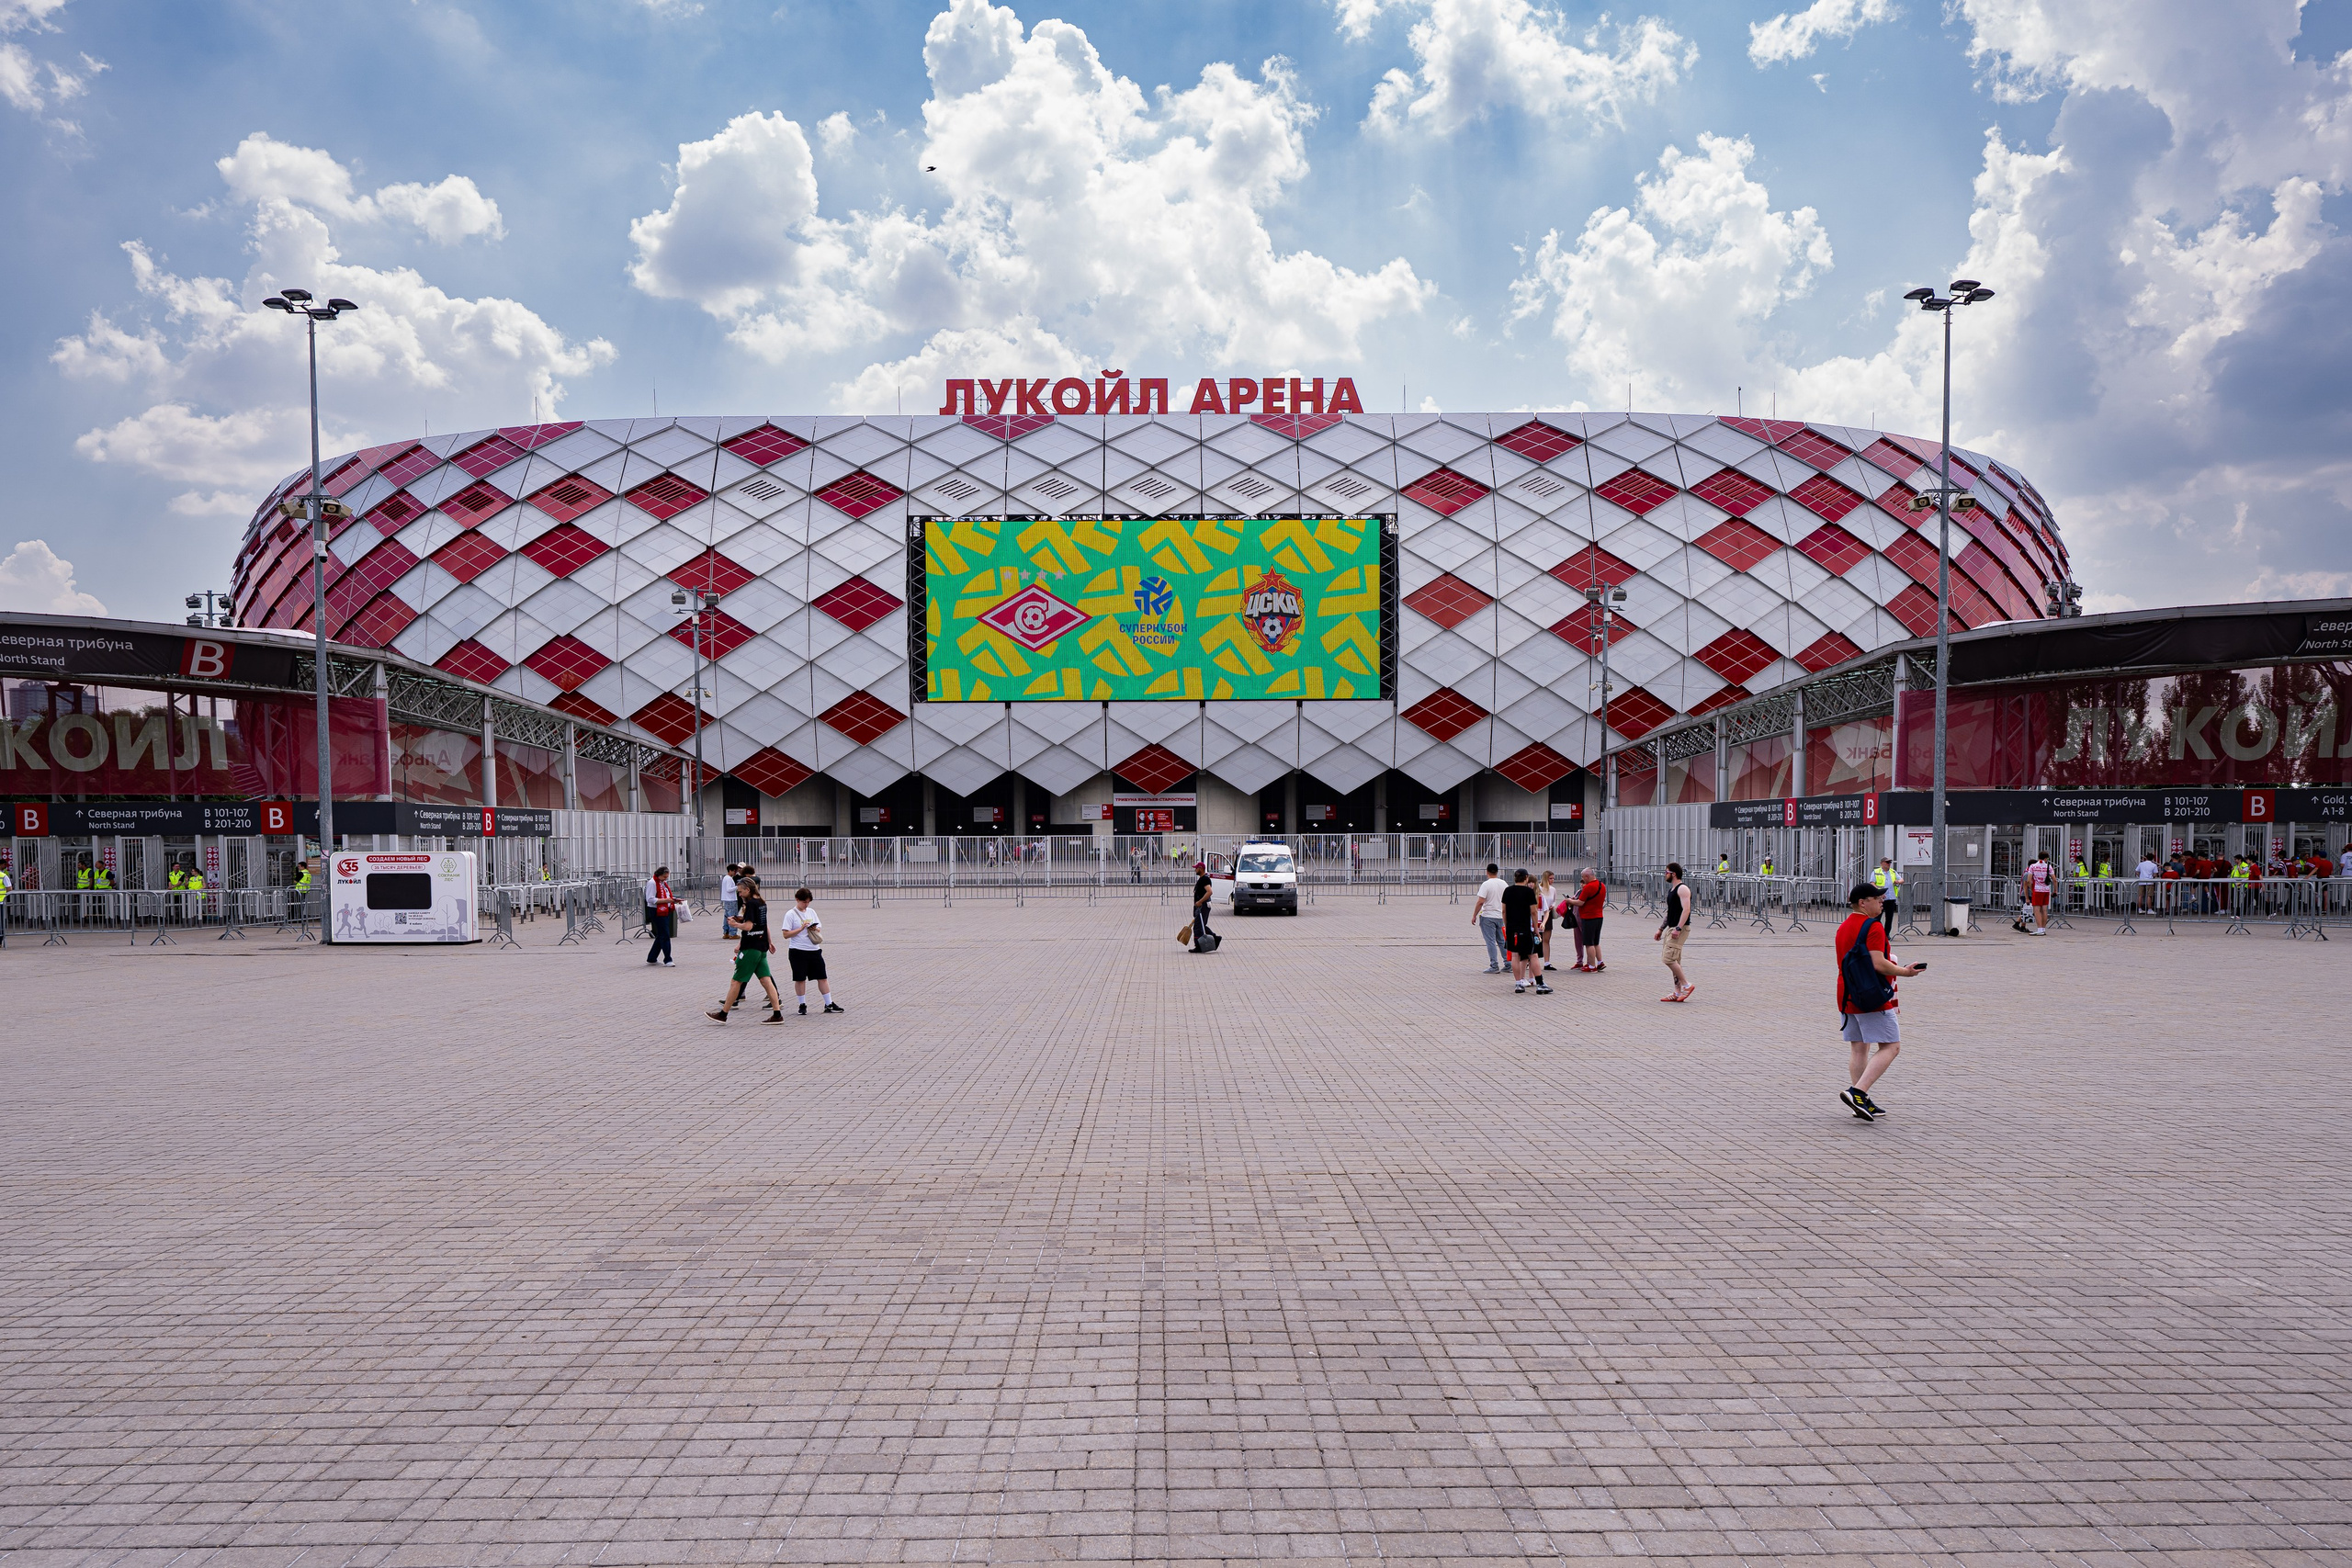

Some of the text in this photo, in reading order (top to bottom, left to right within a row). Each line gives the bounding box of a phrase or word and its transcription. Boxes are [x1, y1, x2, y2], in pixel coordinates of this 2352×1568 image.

[940, 369, 1364, 415] ЛУКОЙЛ АРЕНА
[1245, 592, 1301, 617] ЦСКА
[1119, 623, 1188, 633] СУПЕРКУБОК
[2313, 620, 2352, 633] евер
[0, 635, 134, 651] еверная трибуна
[1132, 635, 1175, 645] РОССИИ
[2306, 639, 2339, 649] North
[30, 655, 65, 666] Stand
[2054, 691, 2352, 761] ЛУКОЙ
[1844, 800, 1860, 808] 101-107
[2053, 797, 2146, 807] Северная трибуна
[2174, 796, 2209, 806] 101-107
[2323, 795, 2347, 805] Gold,
[1804, 800, 1840, 812] Северная трибуна
[87, 808, 183, 819] Северная трибуна
[214, 808, 249, 818] 101-107
[419, 809, 460, 821] Северная трибуна
[1844, 810, 1860, 818] 201-210
[2174, 807, 2211, 817] 201-210
[2332, 807, 2345, 816] 1-8
[88, 821, 135, 829] North Stand
[214, 818, 252, 829] 201-210
[466, 822, 482, 830] 201-210
[345, 862, 359, 872] 35
